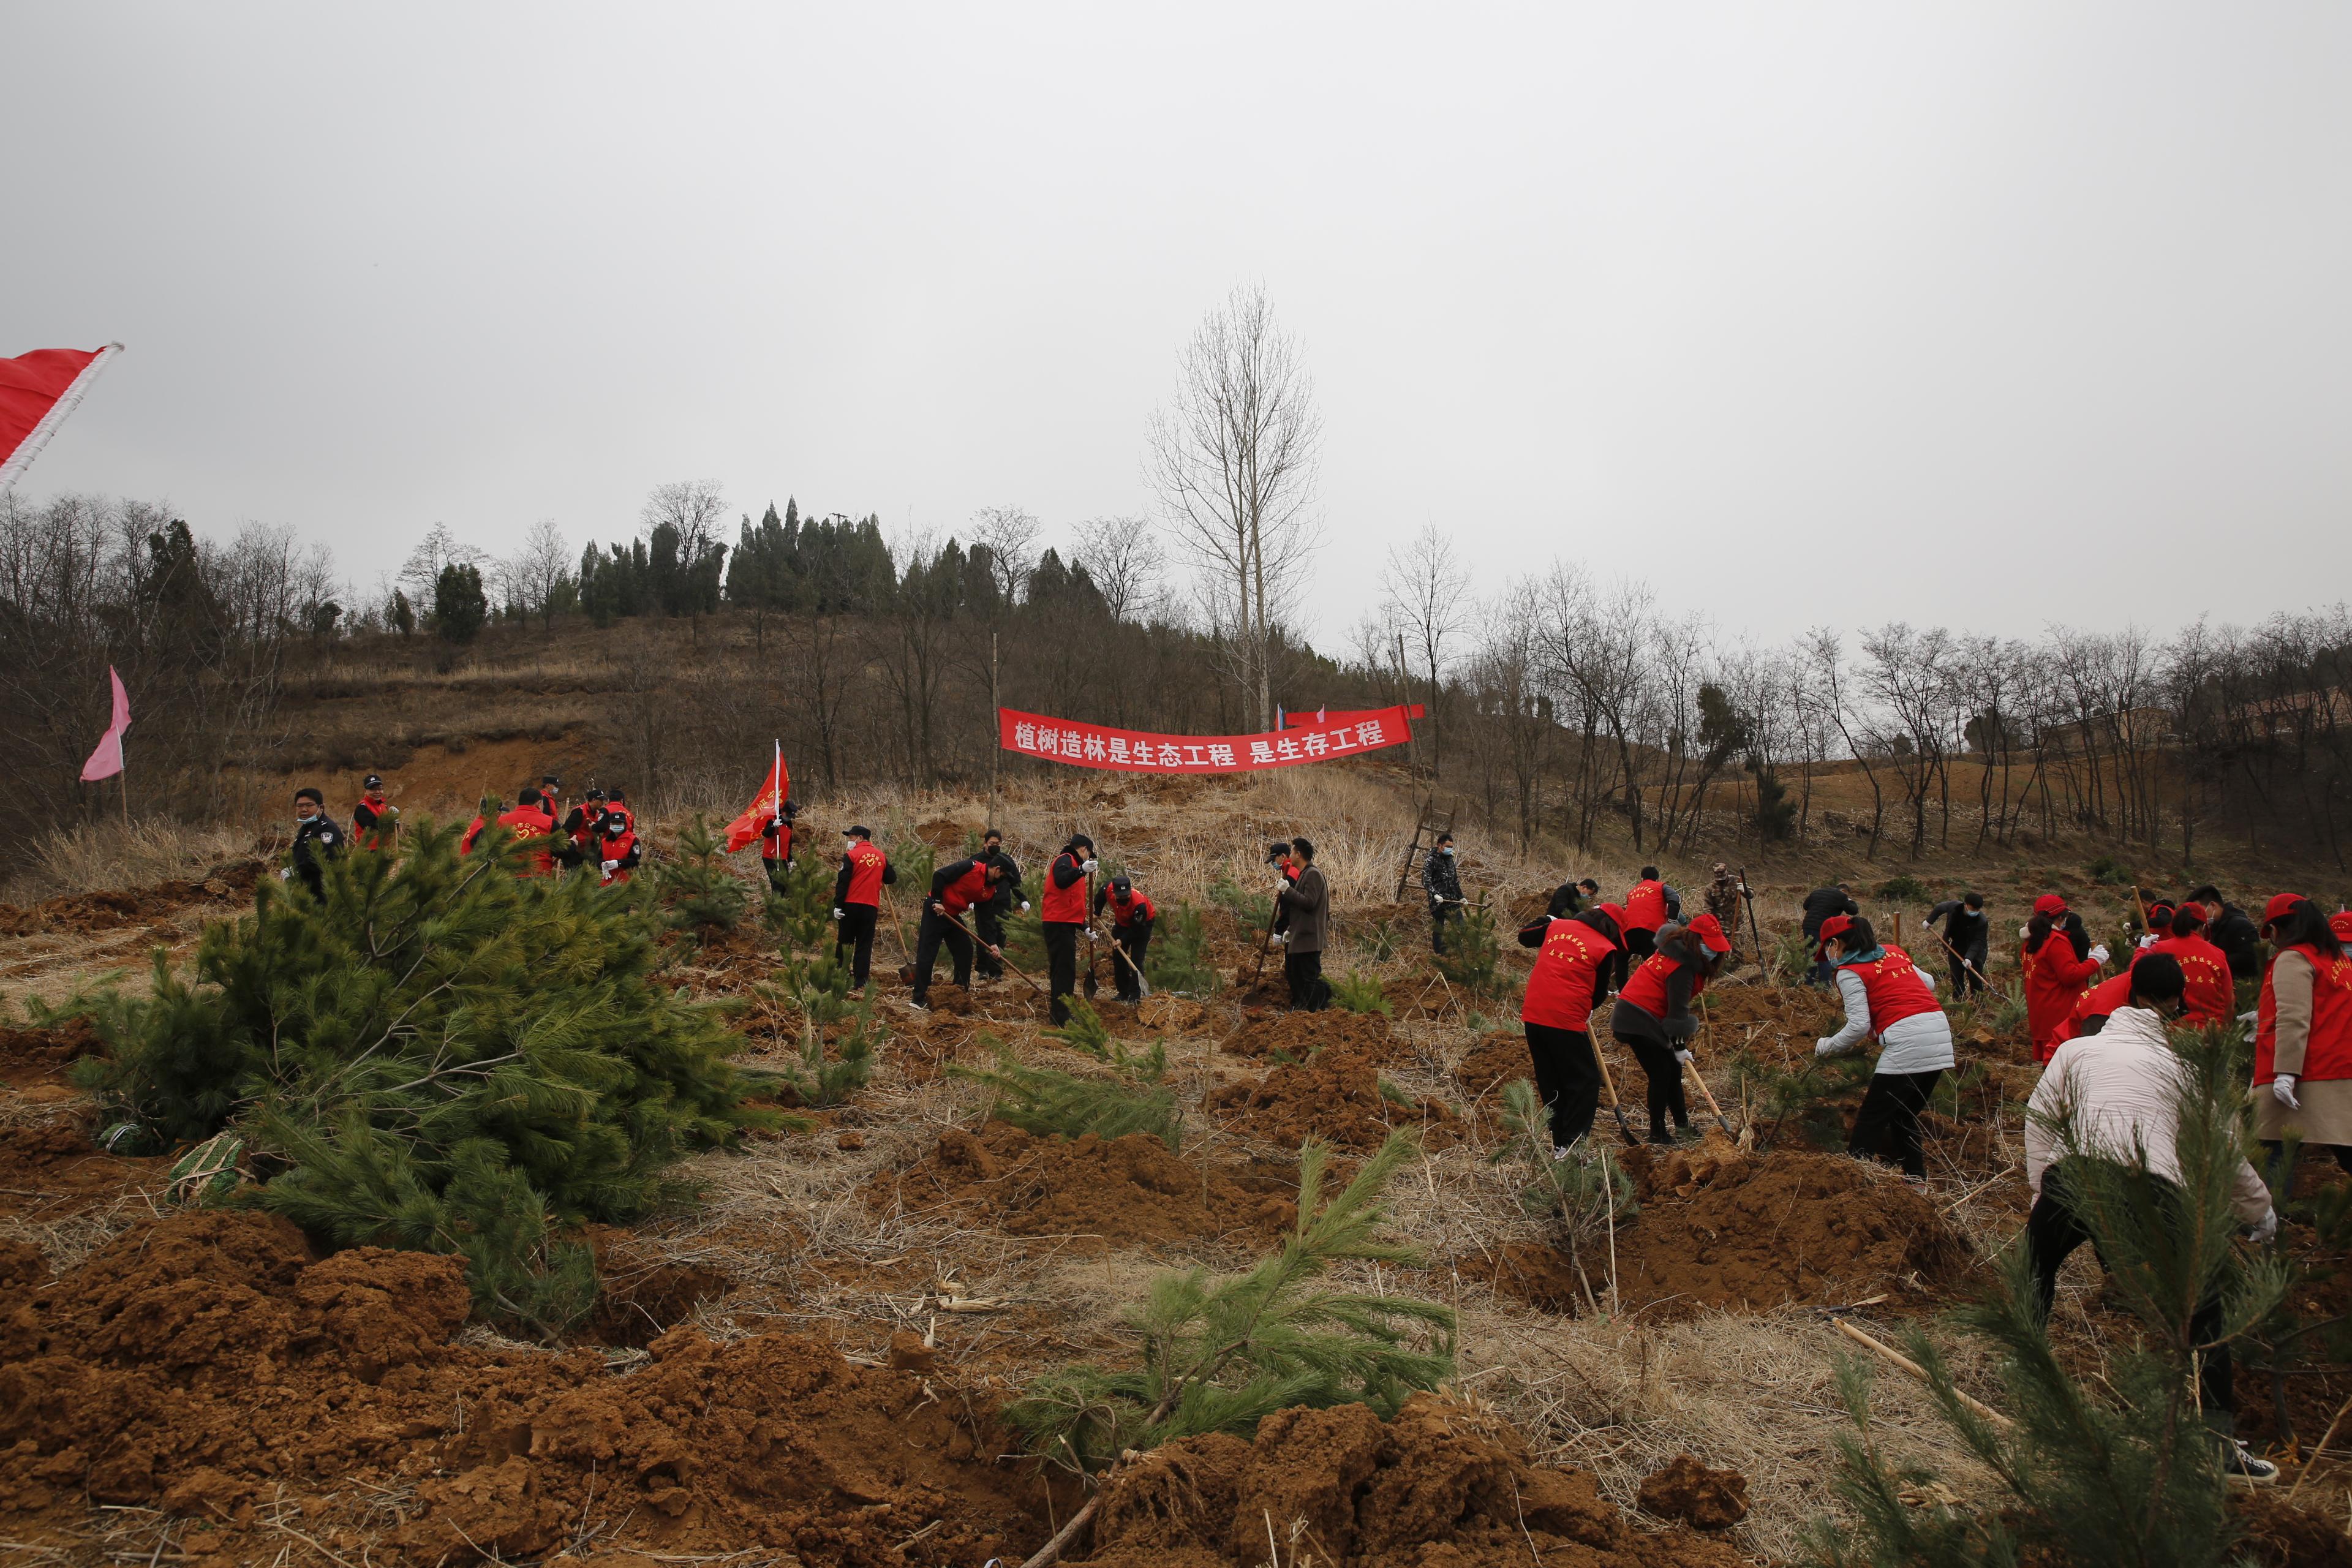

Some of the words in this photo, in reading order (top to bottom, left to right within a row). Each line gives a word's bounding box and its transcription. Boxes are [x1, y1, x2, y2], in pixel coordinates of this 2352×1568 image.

[1014, 720, 1237, 767] 植树造林是生态工程
[1250, 719, 1385, 764] 是生存工程
